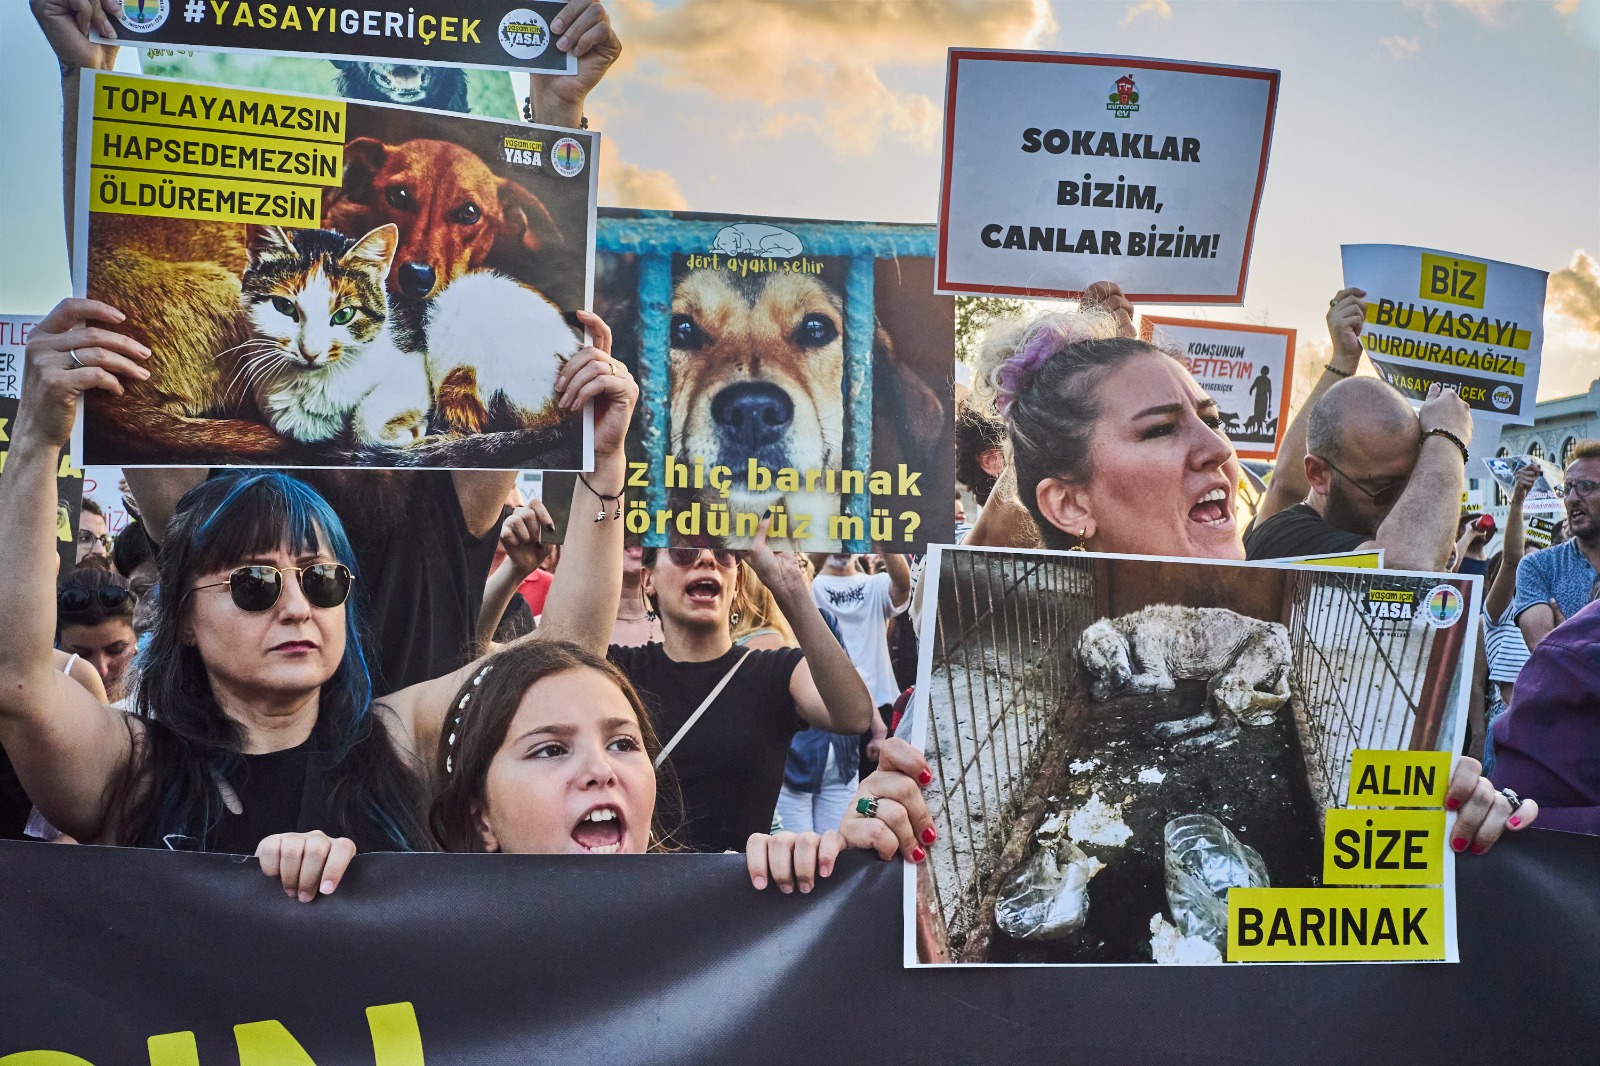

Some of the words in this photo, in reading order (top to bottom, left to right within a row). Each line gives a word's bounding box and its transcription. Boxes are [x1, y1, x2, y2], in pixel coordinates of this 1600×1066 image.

[184, 0, 481, 46] #YASAYIGERİÇEK
[507, 32, 540, 45] YASA
[101, 85, 341, 134] TOPLAYAMAZSIN
[102, 132, 338, 178] HAPSEDEMEZSİN
[504, 148, 542, 167] YASA
[1020, 127, 1201, 163] SOKAKLAR
[99, 174, 316, 221] ÖLDÜREMEZSİN
[1056, 172, 1164, 214] BİZİM,
[980, 223, 1122, 256] CANLAR
[1127, 224, 1221, 259] BİZİM!
[686, 253, 721, 271] dört
[727, 257, 778, 277] ayaklı
[783, 258, 825, 276] şehir
[1431, 261, 1478, 301] BİZ
[0, 322, 36, 346] TLE
[1375, 298, 1415, 329] BU
[1421, 305, 1518, 348] YASAYI
[1187, 342, 1246, 359] KOMŞUNUM
[1367, 332, 1519, 375] DURDURACAĞIZ!
[665, 455, 733, 499] hiç
[747, 458, 922, 497] barınak
[625, 501, 813, 540] ördünüz
[828, 508, 922, 542] mü?
[1368, 601, 1412, 619] YASA
[1356, 764, 1436, 796] ALIN
[1333, 818, 1429, 870] SİZE
[1237, 907, 1429, 947] BARINAK
